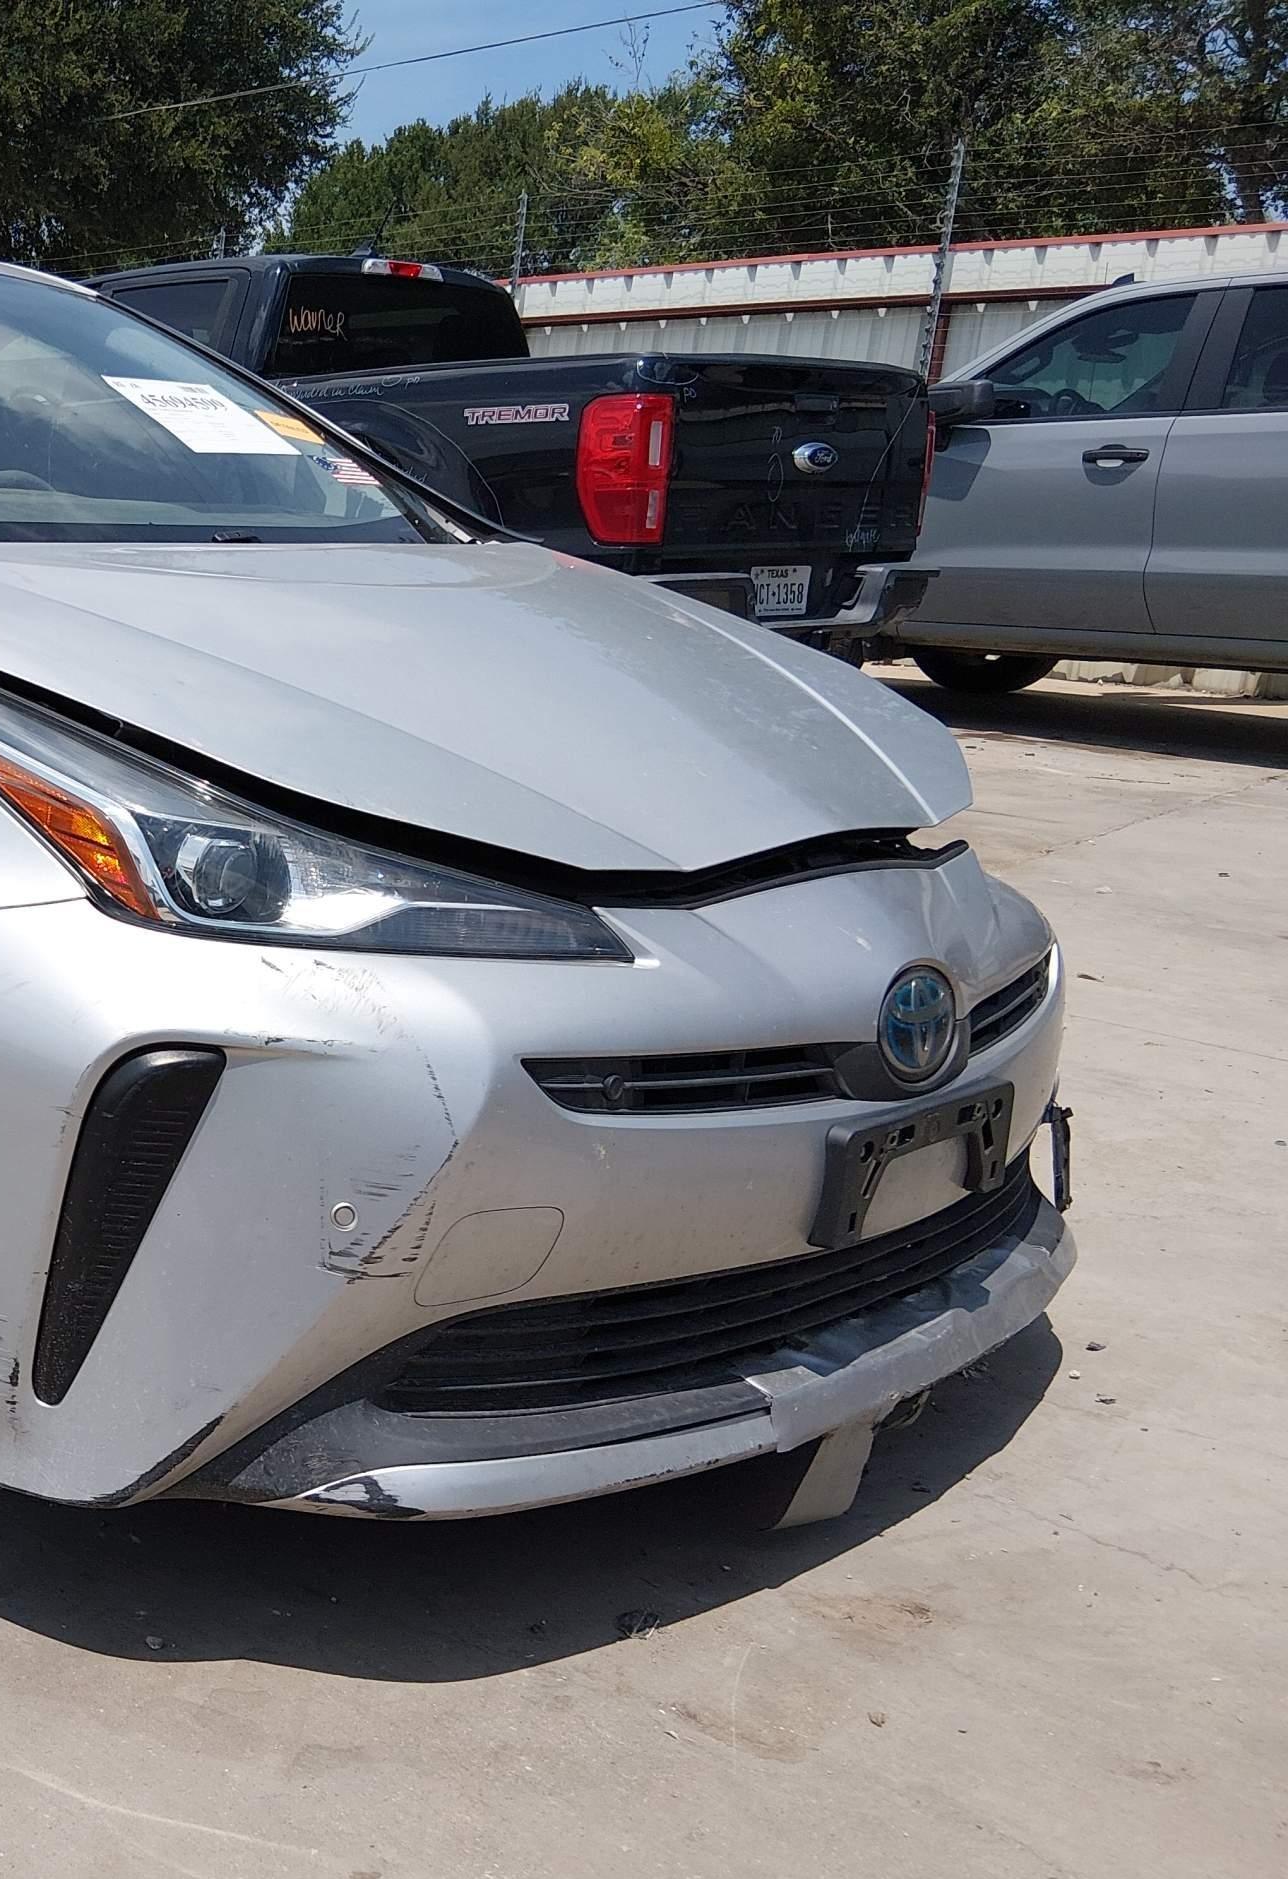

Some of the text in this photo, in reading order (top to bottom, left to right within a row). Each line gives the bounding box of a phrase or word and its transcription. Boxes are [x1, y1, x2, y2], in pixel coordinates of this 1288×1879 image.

[463, 403, 570, 426] TREMOR
[814, 449, 834, 464] Ford
[767, 568, 789, 579] TEXAS
